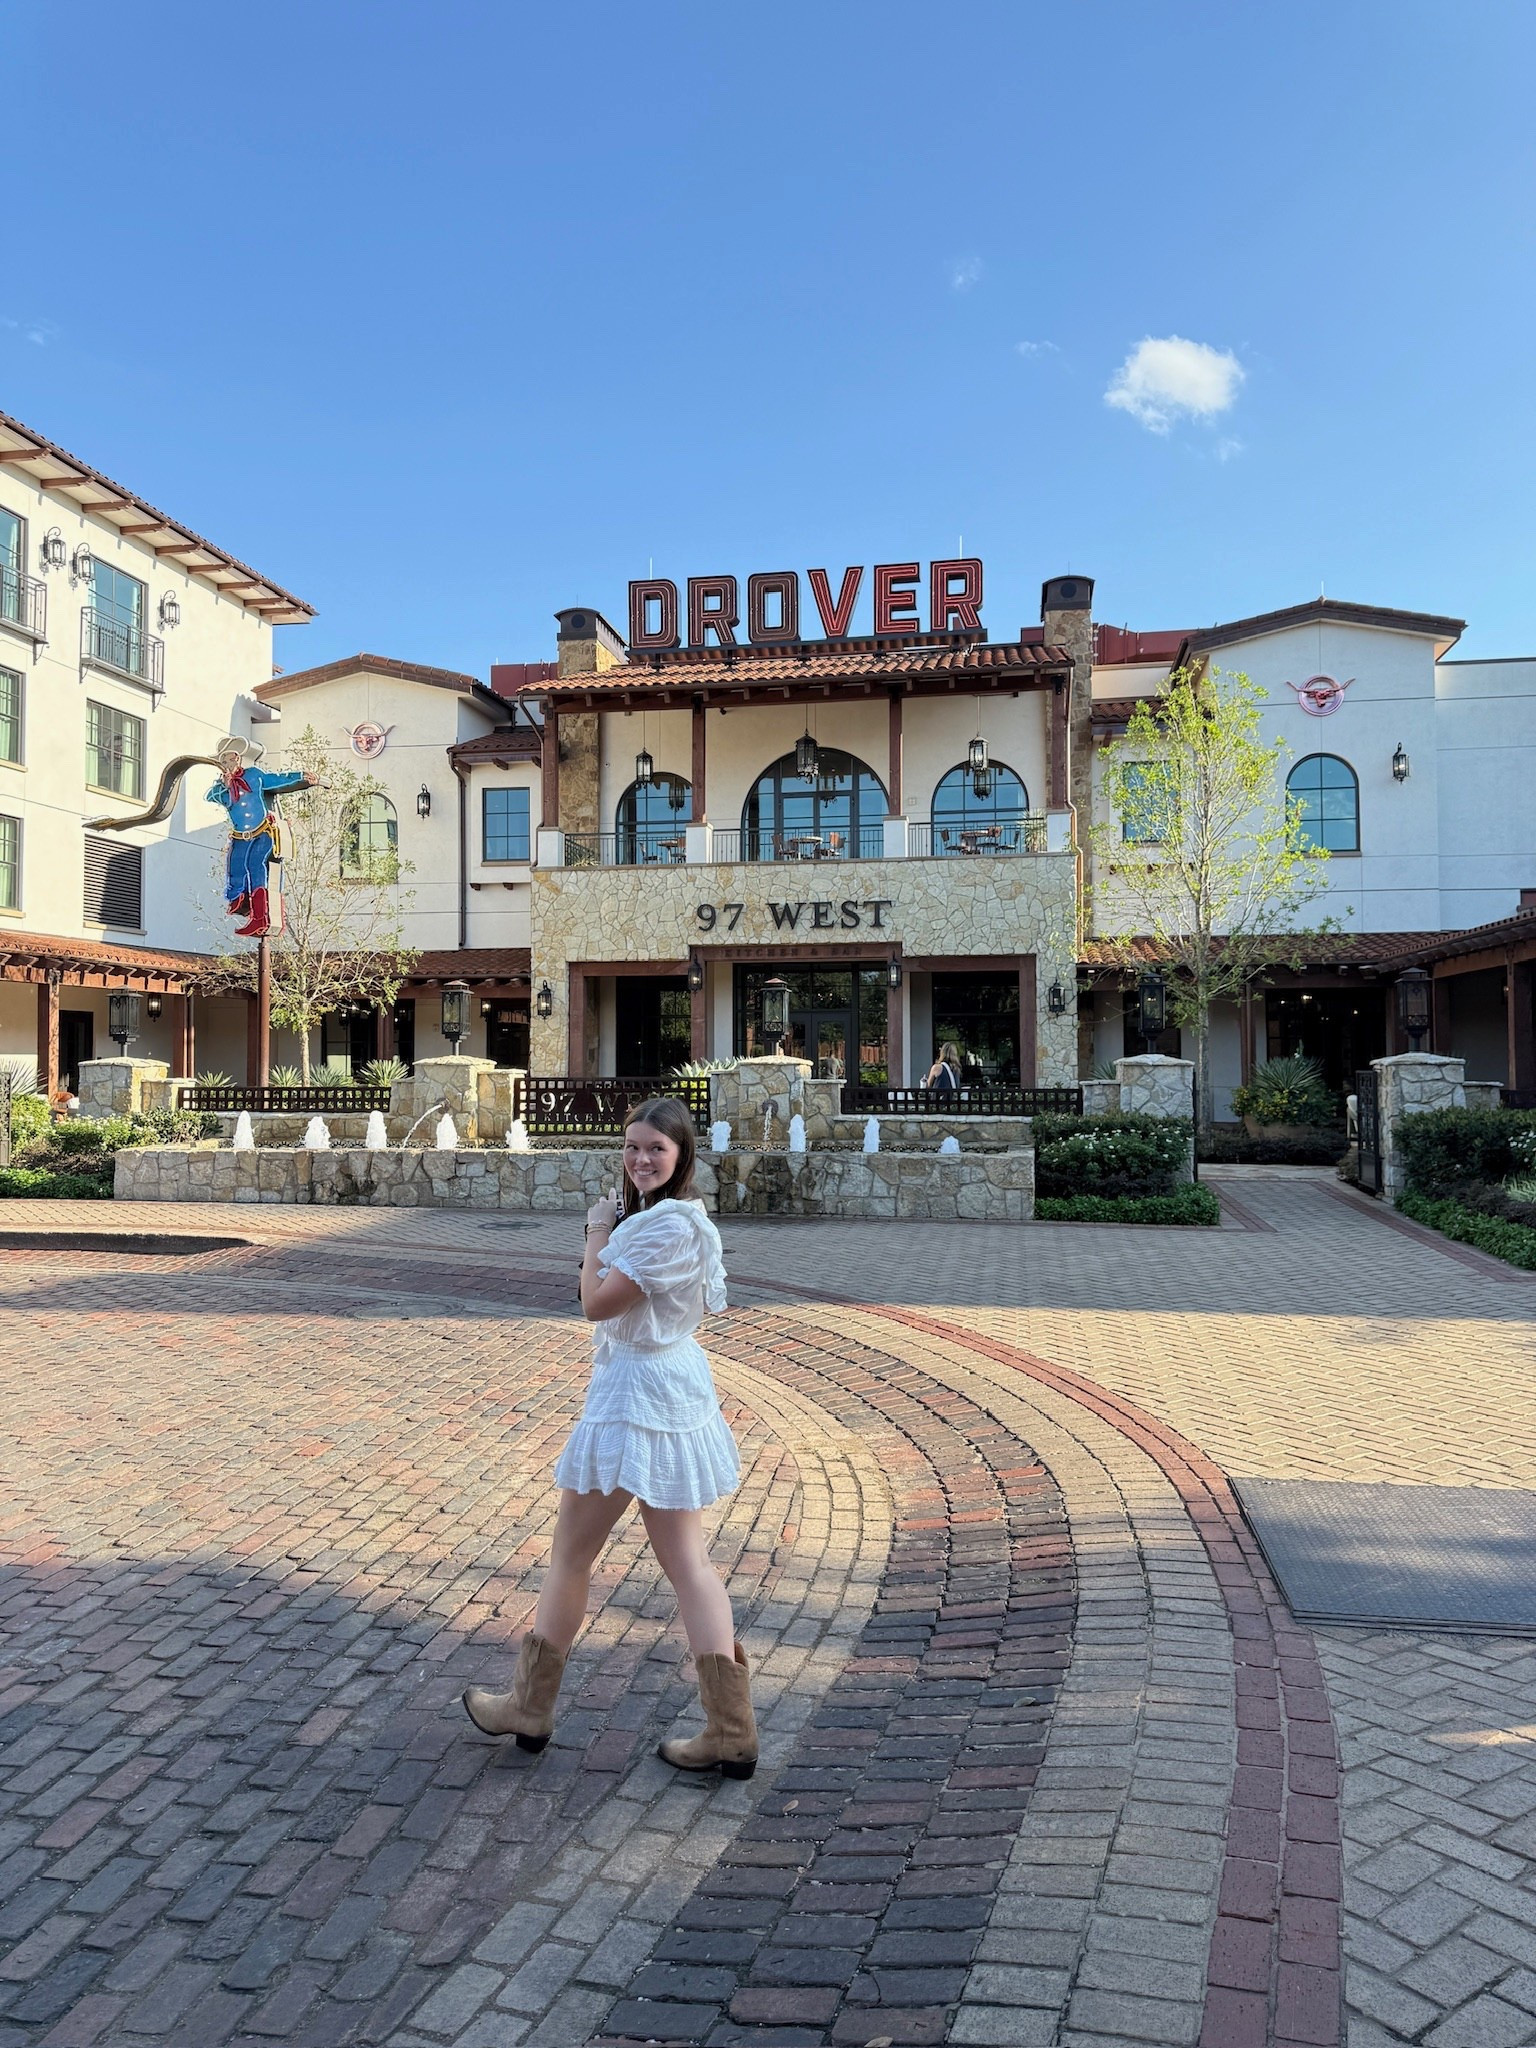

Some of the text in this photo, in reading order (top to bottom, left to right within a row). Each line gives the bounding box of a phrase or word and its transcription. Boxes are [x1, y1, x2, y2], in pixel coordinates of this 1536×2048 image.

[628, 558, 984, 649] DROVER
[696, 900, 892, 931] 97 WEST
[725, 948, 799, 957] KITCHEN
[540, 1092, 685, 1112] 97 WE
